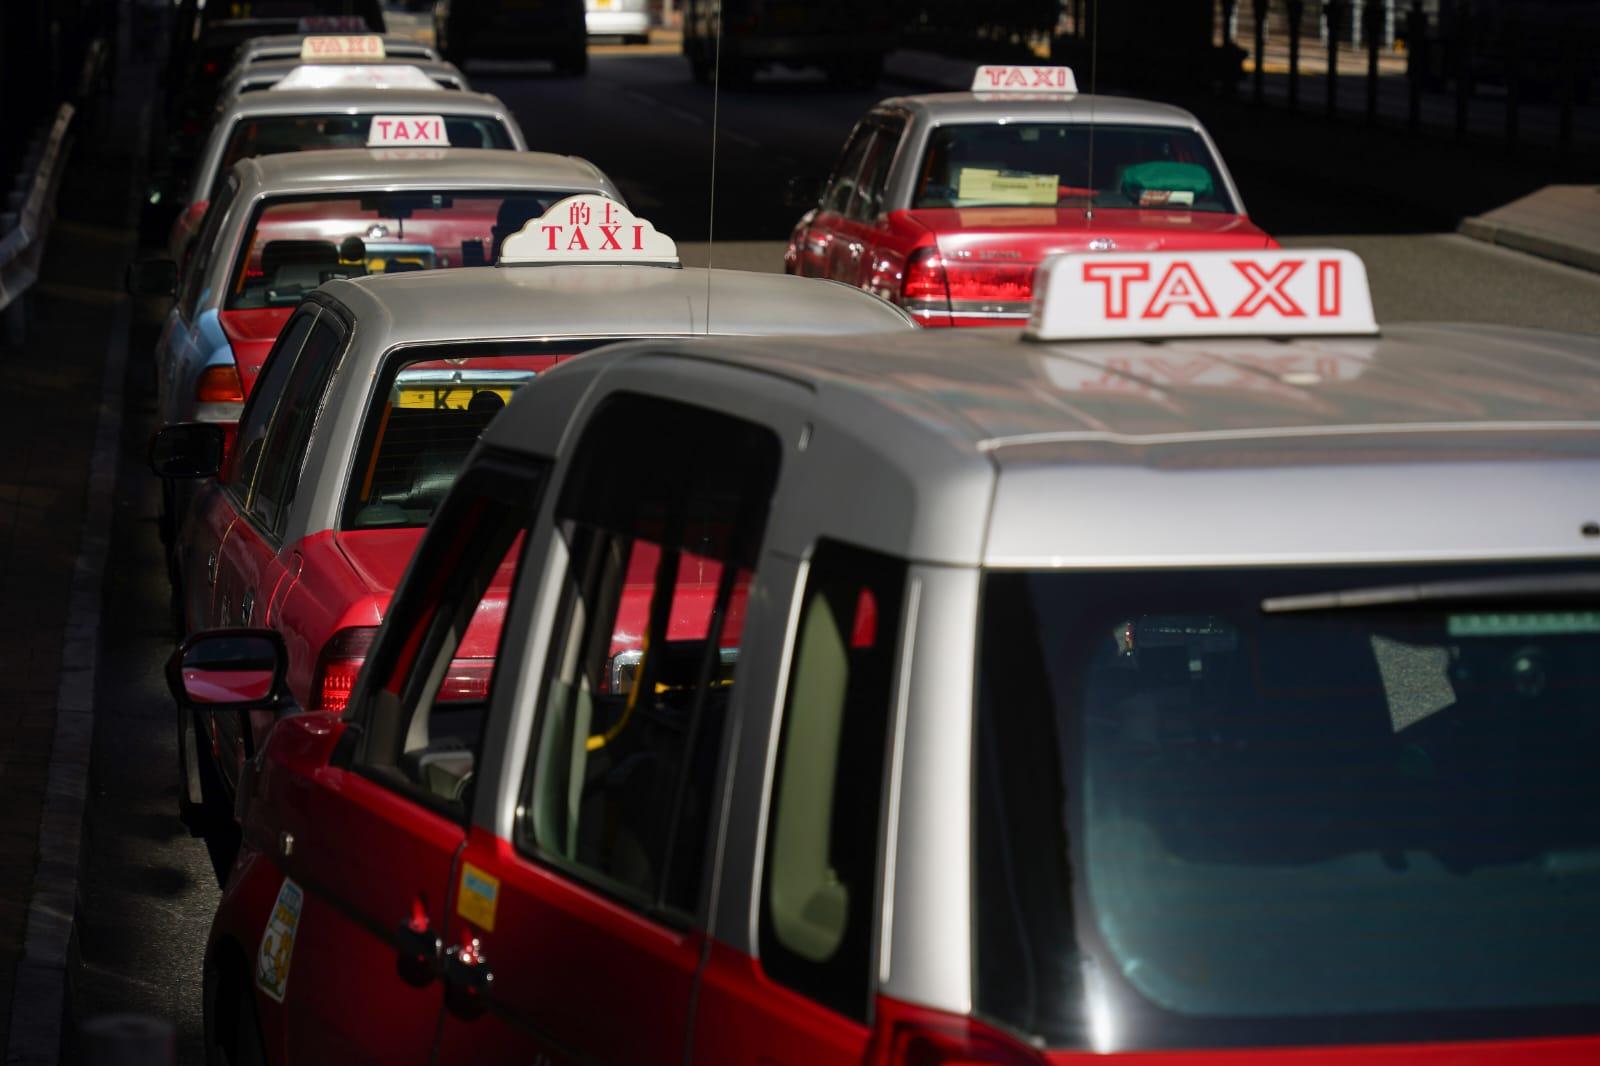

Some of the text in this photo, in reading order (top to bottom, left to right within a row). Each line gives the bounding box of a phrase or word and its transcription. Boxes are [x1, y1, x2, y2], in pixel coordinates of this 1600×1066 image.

[984, 68, 1066, 87] TAXI
[378, 121, 440, 140] TAXI
[569, 202, 619, 226] 的士
[541, 225, 644, 250] TAXI
[1083, 260, 1343, 319] TAXI
